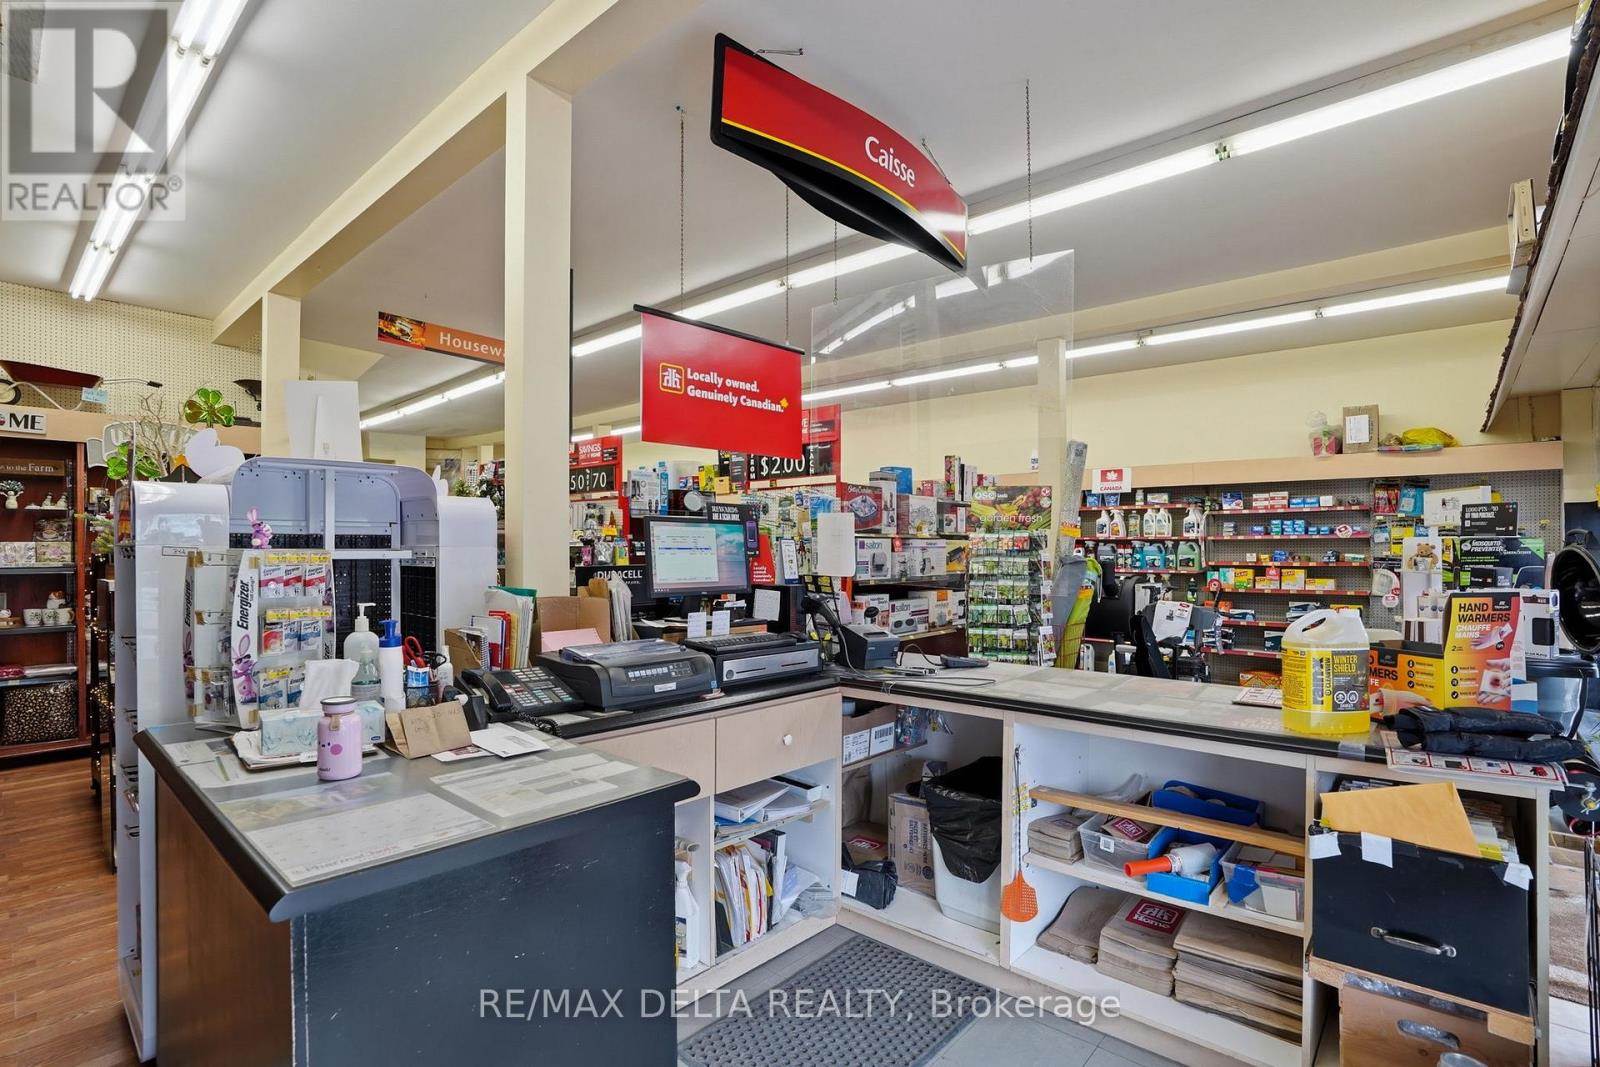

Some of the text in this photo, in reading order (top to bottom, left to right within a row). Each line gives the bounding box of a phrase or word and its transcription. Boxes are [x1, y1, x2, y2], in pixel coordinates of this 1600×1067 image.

[864, 135, 916, 188] Caisse
[439, 331, 504, 357] Housew
[686, 368, 760, 392] Locally owned.
[686, 385, 784, 413] Genuinely Canadian.
[28, 463, 54, 472] Farm
[592, 471, 607, 489] 70
[980, 513, 1043, 523] garden fresh
[184, 579, 192, 627] Energizer
[237, 579, 252, 631] Energizer
[1458, 603, 1489, 612] HAND
[1458, 613, 1511, 623] WARMERS
[1456, 624, 1491, 632] CHAUFFE
[1454, 631, 1481, 639] MAINS
[1333, 654, 1358, 664] WINTER
[1333, 663, 1356, 673] SHIELD
